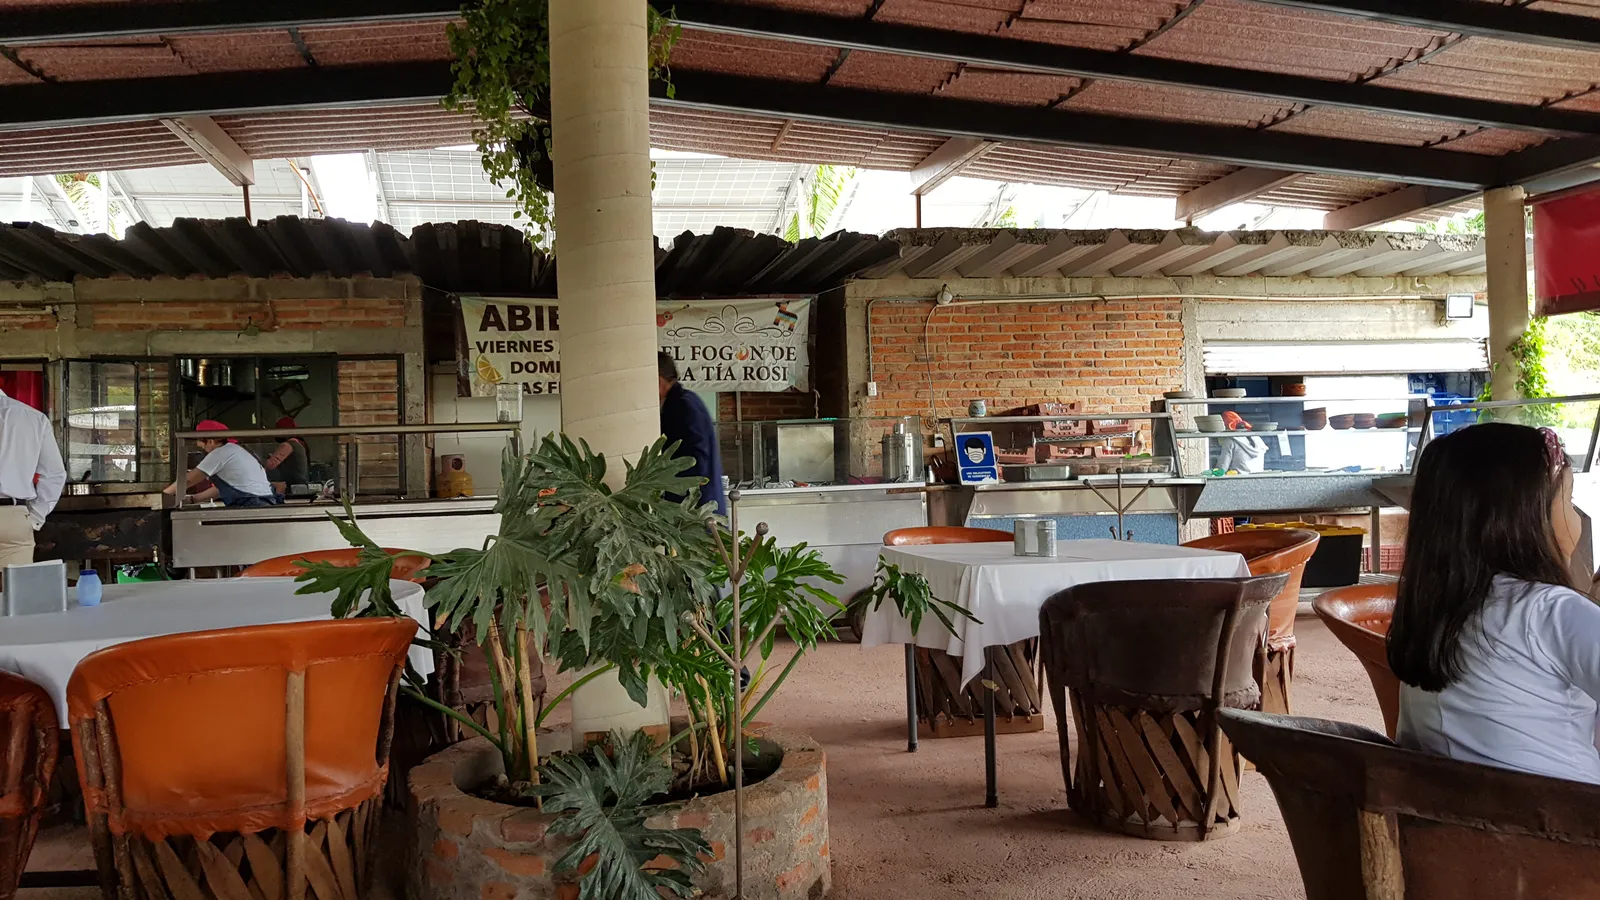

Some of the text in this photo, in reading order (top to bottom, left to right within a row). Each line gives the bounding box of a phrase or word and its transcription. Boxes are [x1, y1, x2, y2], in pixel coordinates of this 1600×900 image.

[479, 304, 560, 331] ABIE
[475, 340, 554, 353] VIERNES
[771, 346, 797, 361] DE
[510, 361, 561, 374] DOMI
[677, 363, 788, 382] A TÍA ROSI
